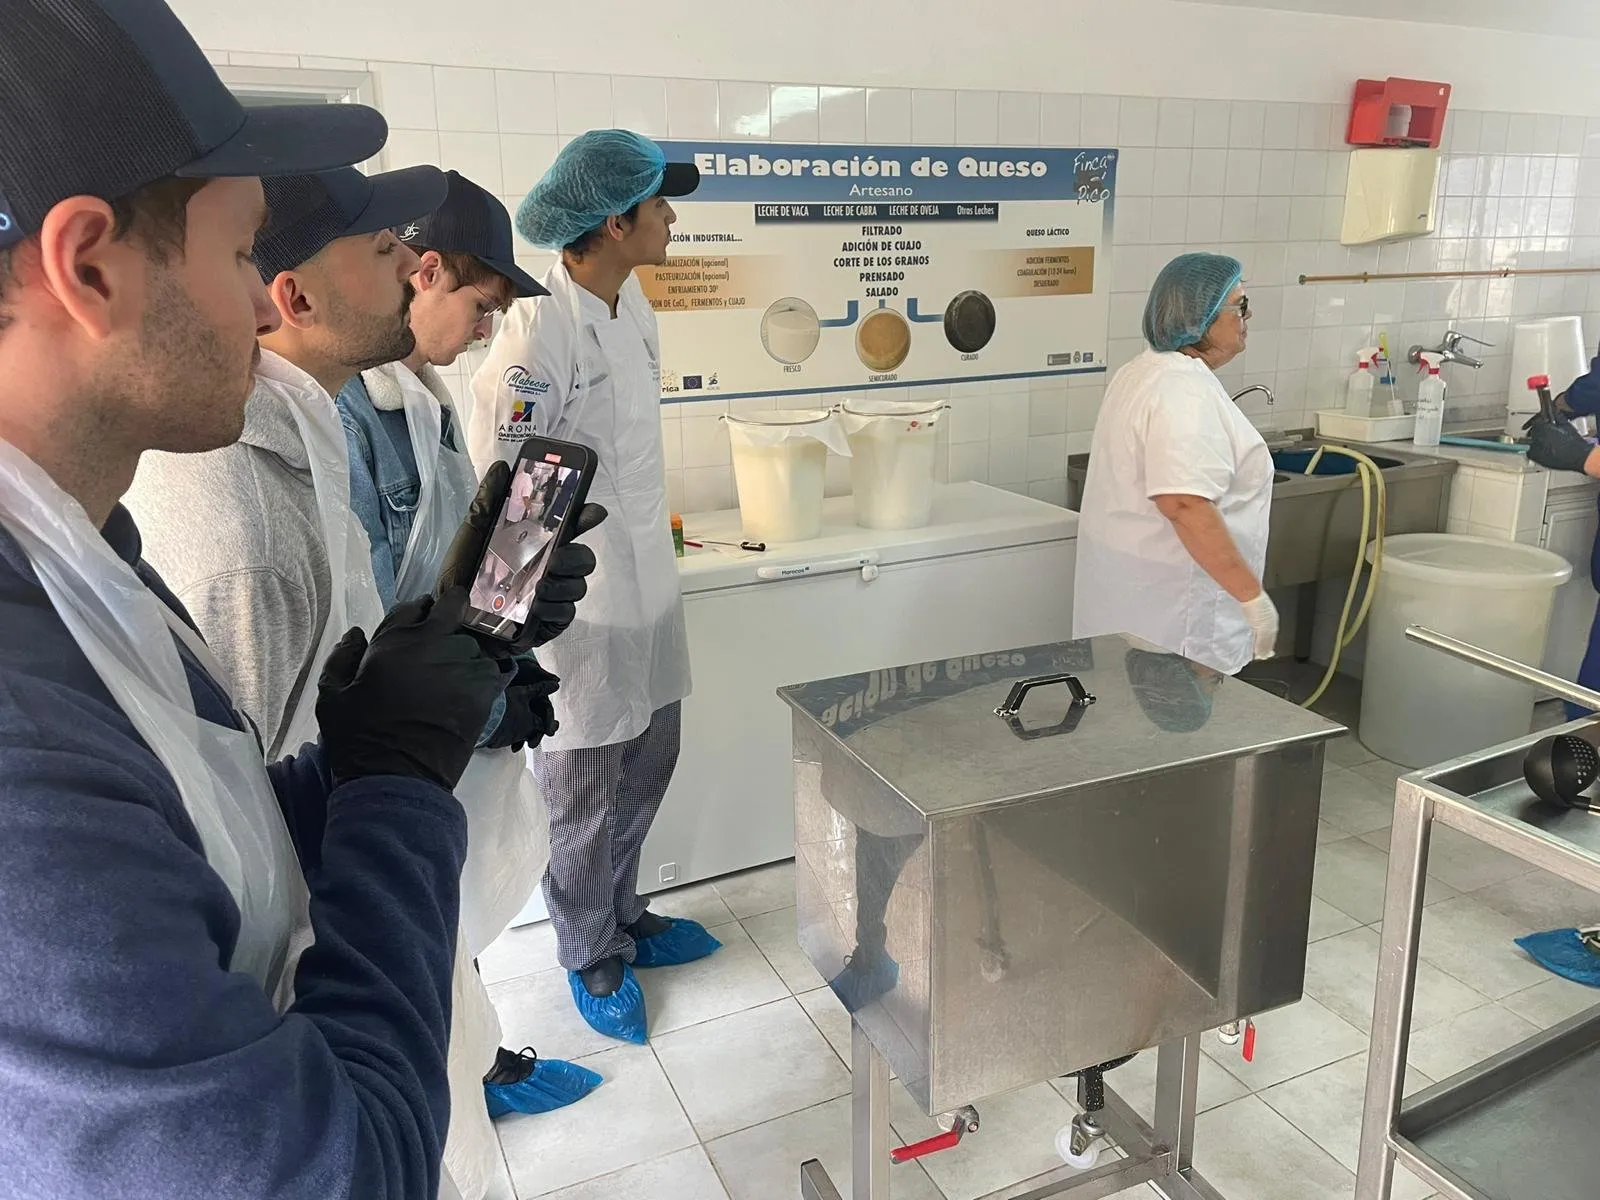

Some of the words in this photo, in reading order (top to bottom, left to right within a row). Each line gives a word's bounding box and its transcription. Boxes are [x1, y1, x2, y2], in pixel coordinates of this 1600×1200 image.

[694, 153, 901, 176] Elaboración
[911, 157, 948, 177] de
[958, 157, 1048, 178] Queso
[1072, 151, 1107, 174] Finca
[849, 184, 913, 197] Artesano
[757, 205, 779, 217] LECHE
[780, 205, 790, 217] DE
[791, 205, 810, 217] VACA
[823, 205, 844, 216] LECHE
[845, 205, 855, 216] DE
[856, 205, 877, 216] CABRA
[889, 205, 908, 216] LECHE
[910, 205, 919, 216] DE
[920, 205, 940, 216] OVEJA
[957, 204, 973, 215] Otros
[974, 204, 994, 215] Leches
[862, 226, 902, 236] FILTRADO
[1026, 229, 1046, 237] QUESO
[1047, 228, 1070, 236] LÁCTICO
[842, 238, 878, 252] ADICIÓN
[881, 241, 892, 251] DE
[895, 240, 921, 251] CUAJO
[833, 257, 860, 268] CORTE
[863, 257, 874, 267] DE
[877, 256, 892, 267] LOS
[895, 255, 930, 266] GRANOS
[655, 271, 701, 281] PASTEURIZACIÓN
[860, 271, 905, 282] PRENSADO
[667, 285, 707, 294] ENFRIAMIENTO
[866, 287, 899, 297] SALADO
[691, 297, 723, 307] FERMENTOS
[728, 297, 746, 306] CUAJO
[961, 353, 979, 361] CURADO
[783, 365, 802, 373] FRESCO
[868, 374, 898, 382] SEMICURADO
[499, 424, 537, 432] ARONA
